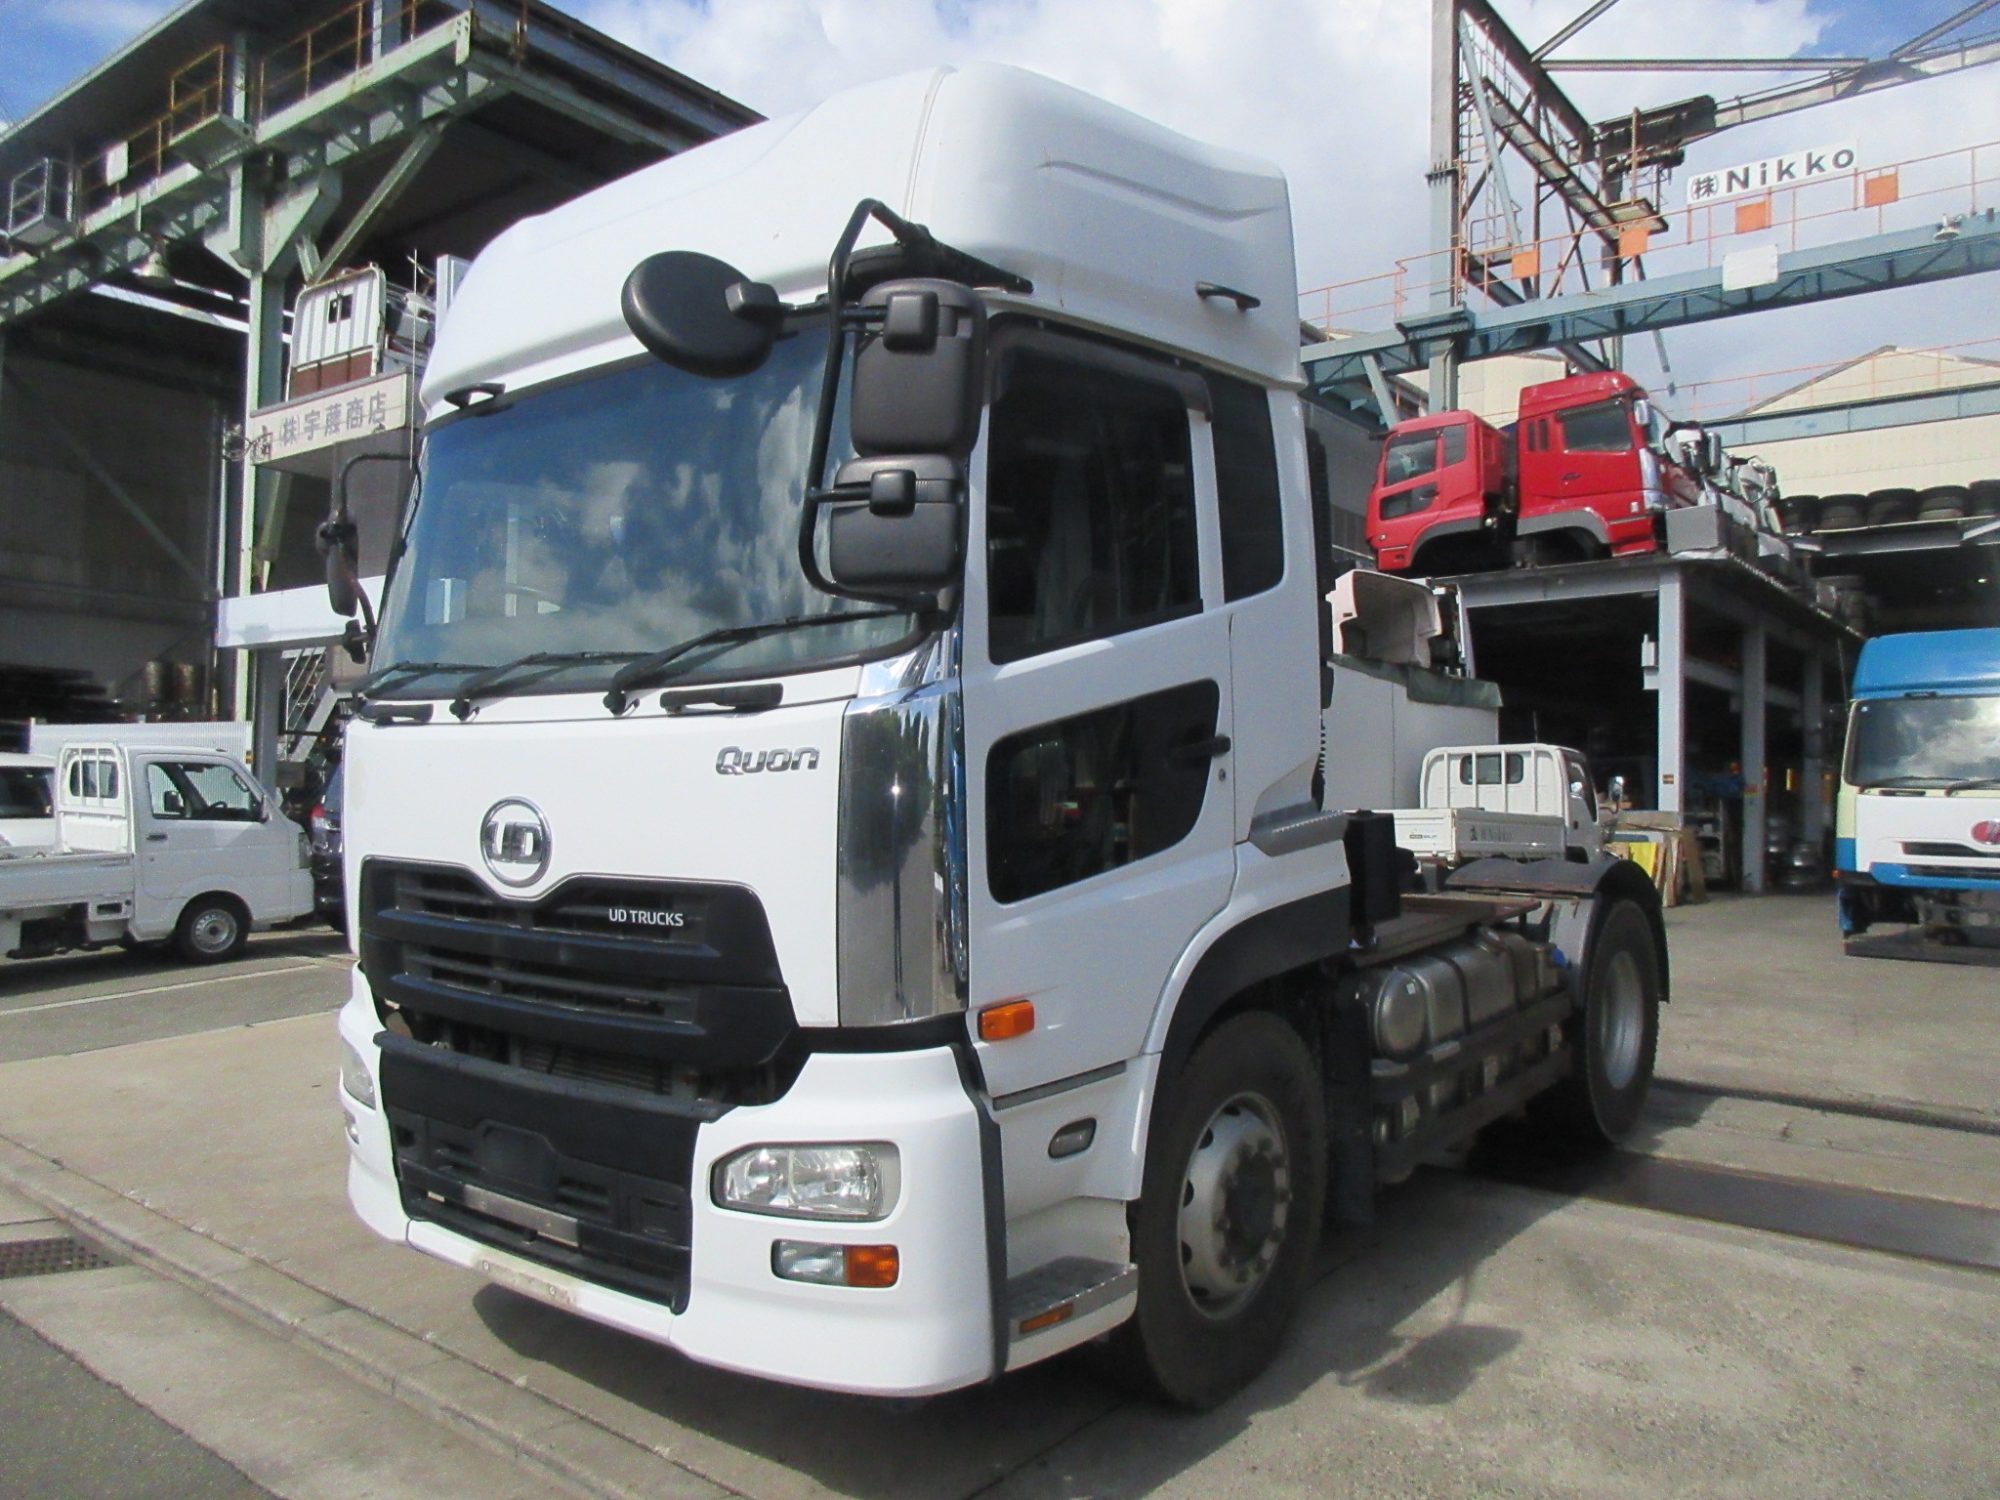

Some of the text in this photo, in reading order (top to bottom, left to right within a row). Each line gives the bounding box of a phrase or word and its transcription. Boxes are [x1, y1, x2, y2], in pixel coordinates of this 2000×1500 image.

[715, 745, 820, 775] Quon
[485, 821, 543, 864] UD
[608, 908, 685, 926] UD TRUCKS
